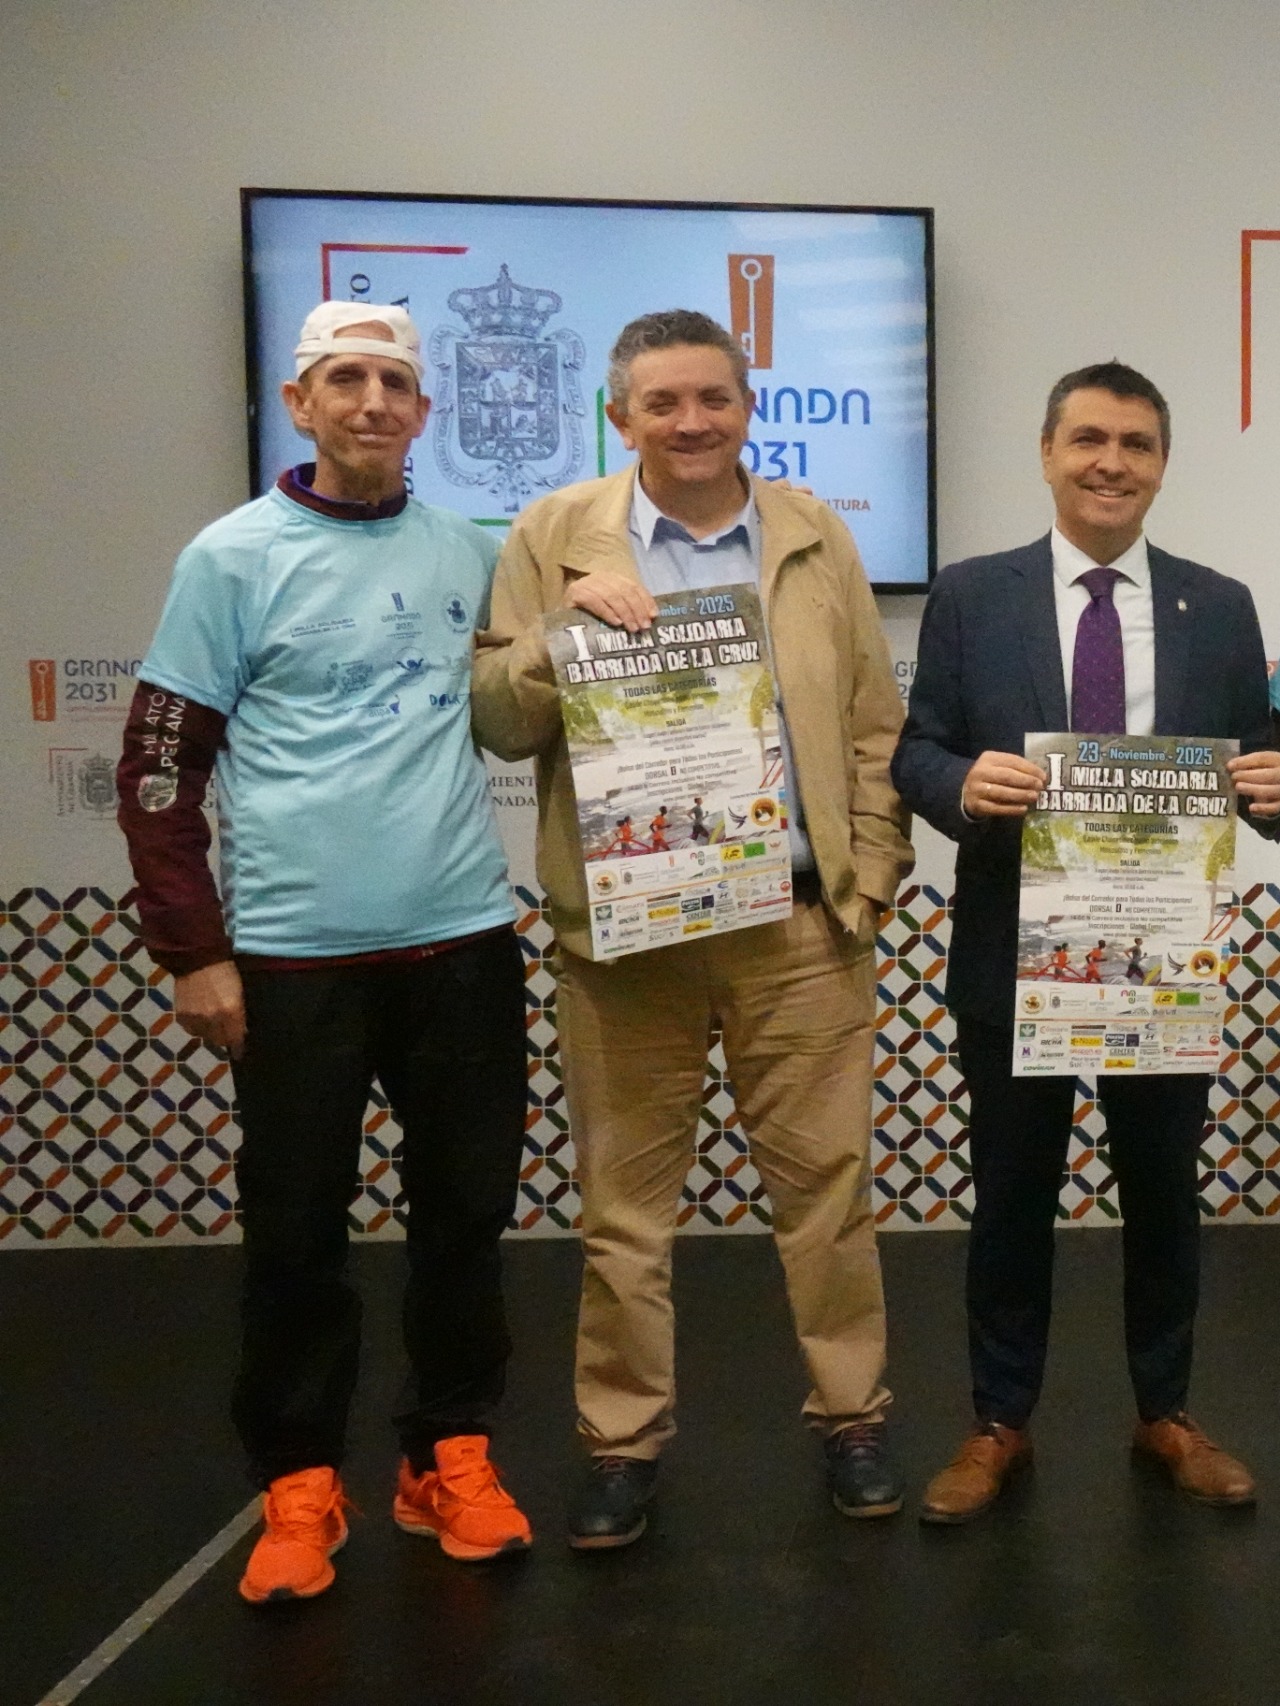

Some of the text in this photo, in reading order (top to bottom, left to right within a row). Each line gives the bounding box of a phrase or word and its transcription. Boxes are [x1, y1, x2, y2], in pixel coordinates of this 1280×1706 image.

[753, 387, 870, 425] NADA
[743, 440, 807, 481] 031
[697, 595, 735, 615] 2025
[565, 624, 594, 661] I
[657, 617, 747, 646] SOLIDARIA
[64, 659, 143, 677] GRANA
[567, 641, 760, 684] BARRIADA DE LA CRUZ
[65, 683, 117, 702] 2031
[623, 686, 650, 698] TODAS
[1078, 742, 1099, 762] 23
[1110, 747, 1166, 761] Noviembre
[1176, 747, 1213, 765] 2025
[1046, 753, 1066, 791] I
[1071, 766, 1219, 791] MILLA SOLIDARIA
[1036, 790, 1228, 817] BARRIADA DE LA CRUZ
[1084, 822, 1111, 833] TODAS
[1112, 823, 1127, 833] LAS
